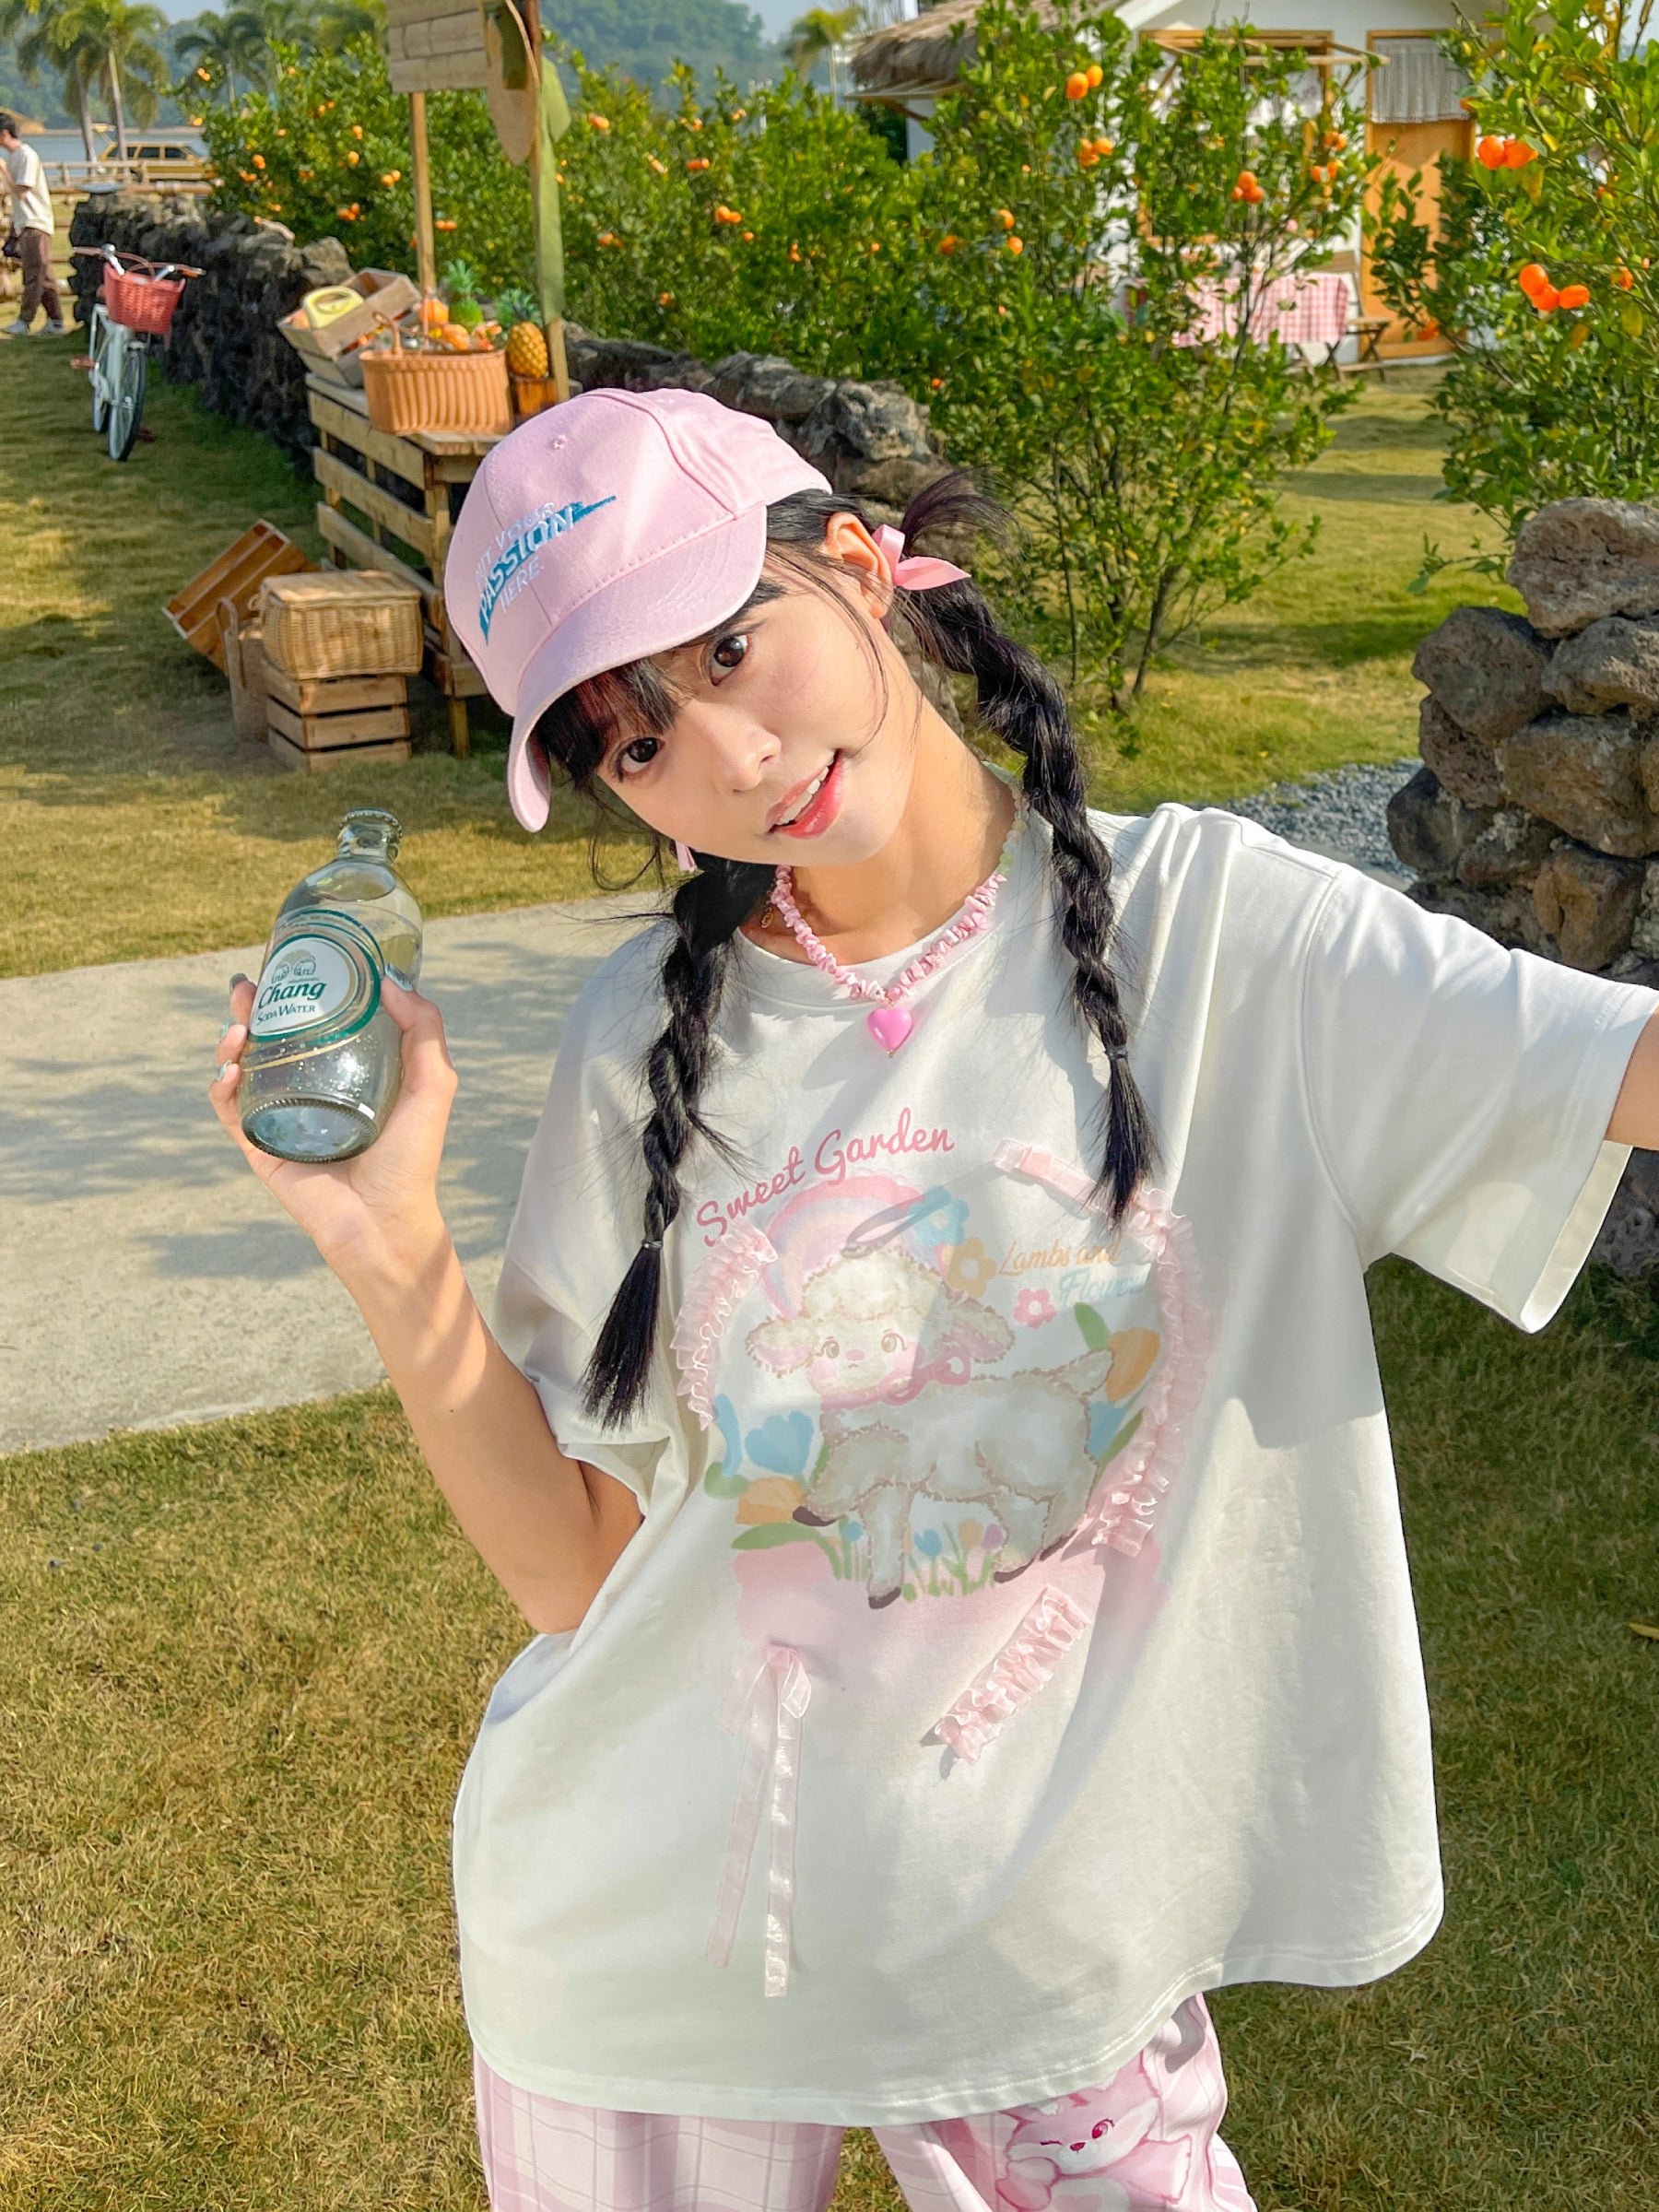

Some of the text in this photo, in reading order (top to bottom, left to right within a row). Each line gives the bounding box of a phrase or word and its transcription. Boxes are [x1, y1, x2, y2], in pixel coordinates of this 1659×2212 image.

[479, 505, 574, 625] PASSION
[258, 982, 327, 1010] Chang
[696, 1106, 956, 1248] Sweet Garden
[998, 1232, 1123, 1277] Lambs and
